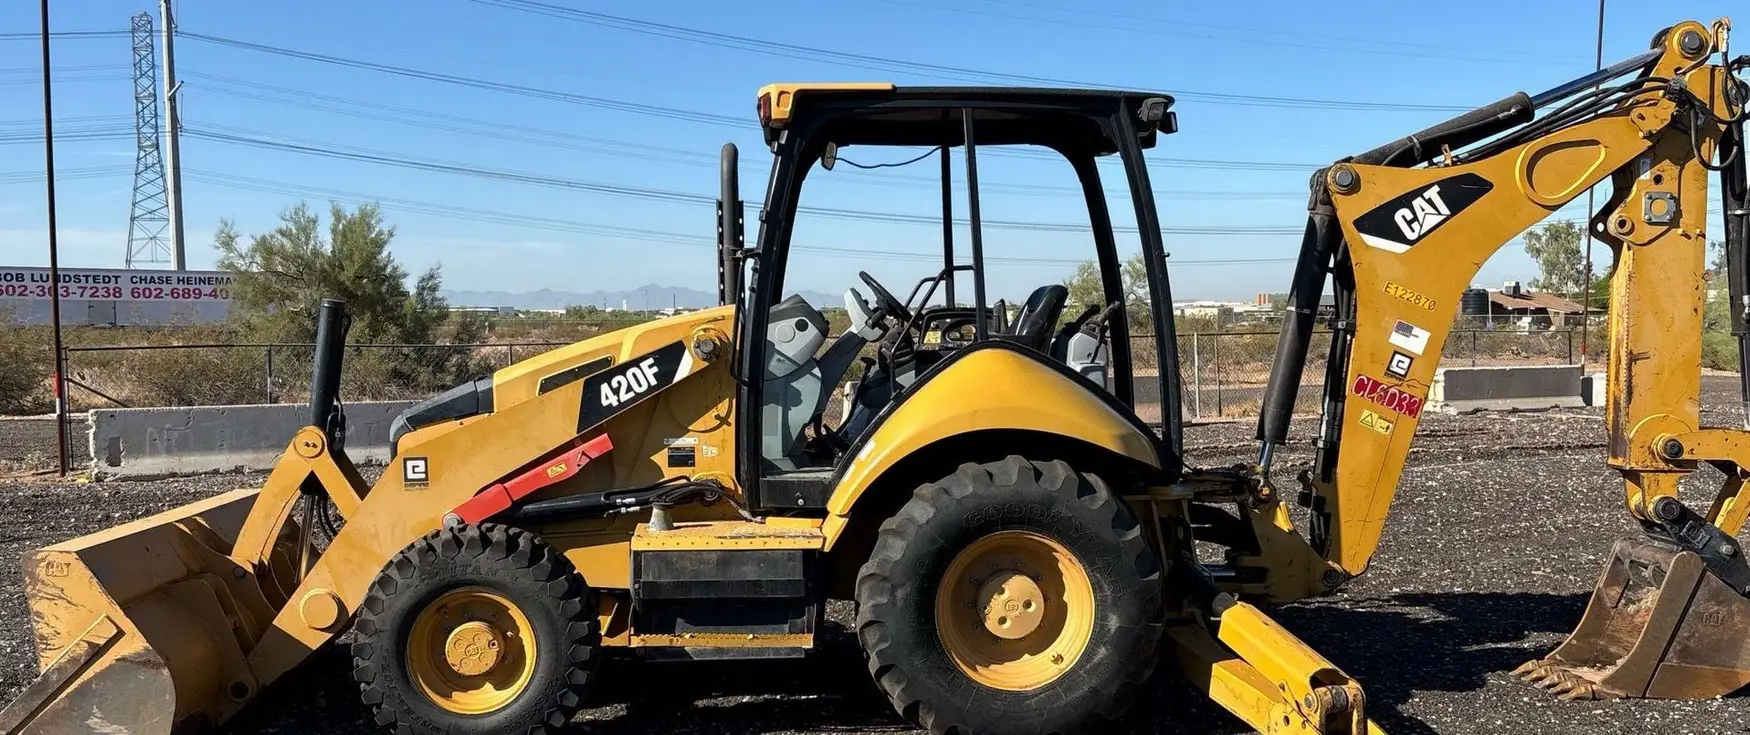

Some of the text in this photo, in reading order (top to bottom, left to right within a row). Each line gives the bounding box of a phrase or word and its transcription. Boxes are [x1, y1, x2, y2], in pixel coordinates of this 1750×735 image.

[1394, 184, 1451, 241] CAT
[0, 272, 121, 285] OB LUDSTEDT
[130, 275, 236, 286] CHASE HEINEMA
[1384, 281, 1437, 311] E122870
[600, 357, 659, 408] 420F
[45, 561, 71, 577] CAT
